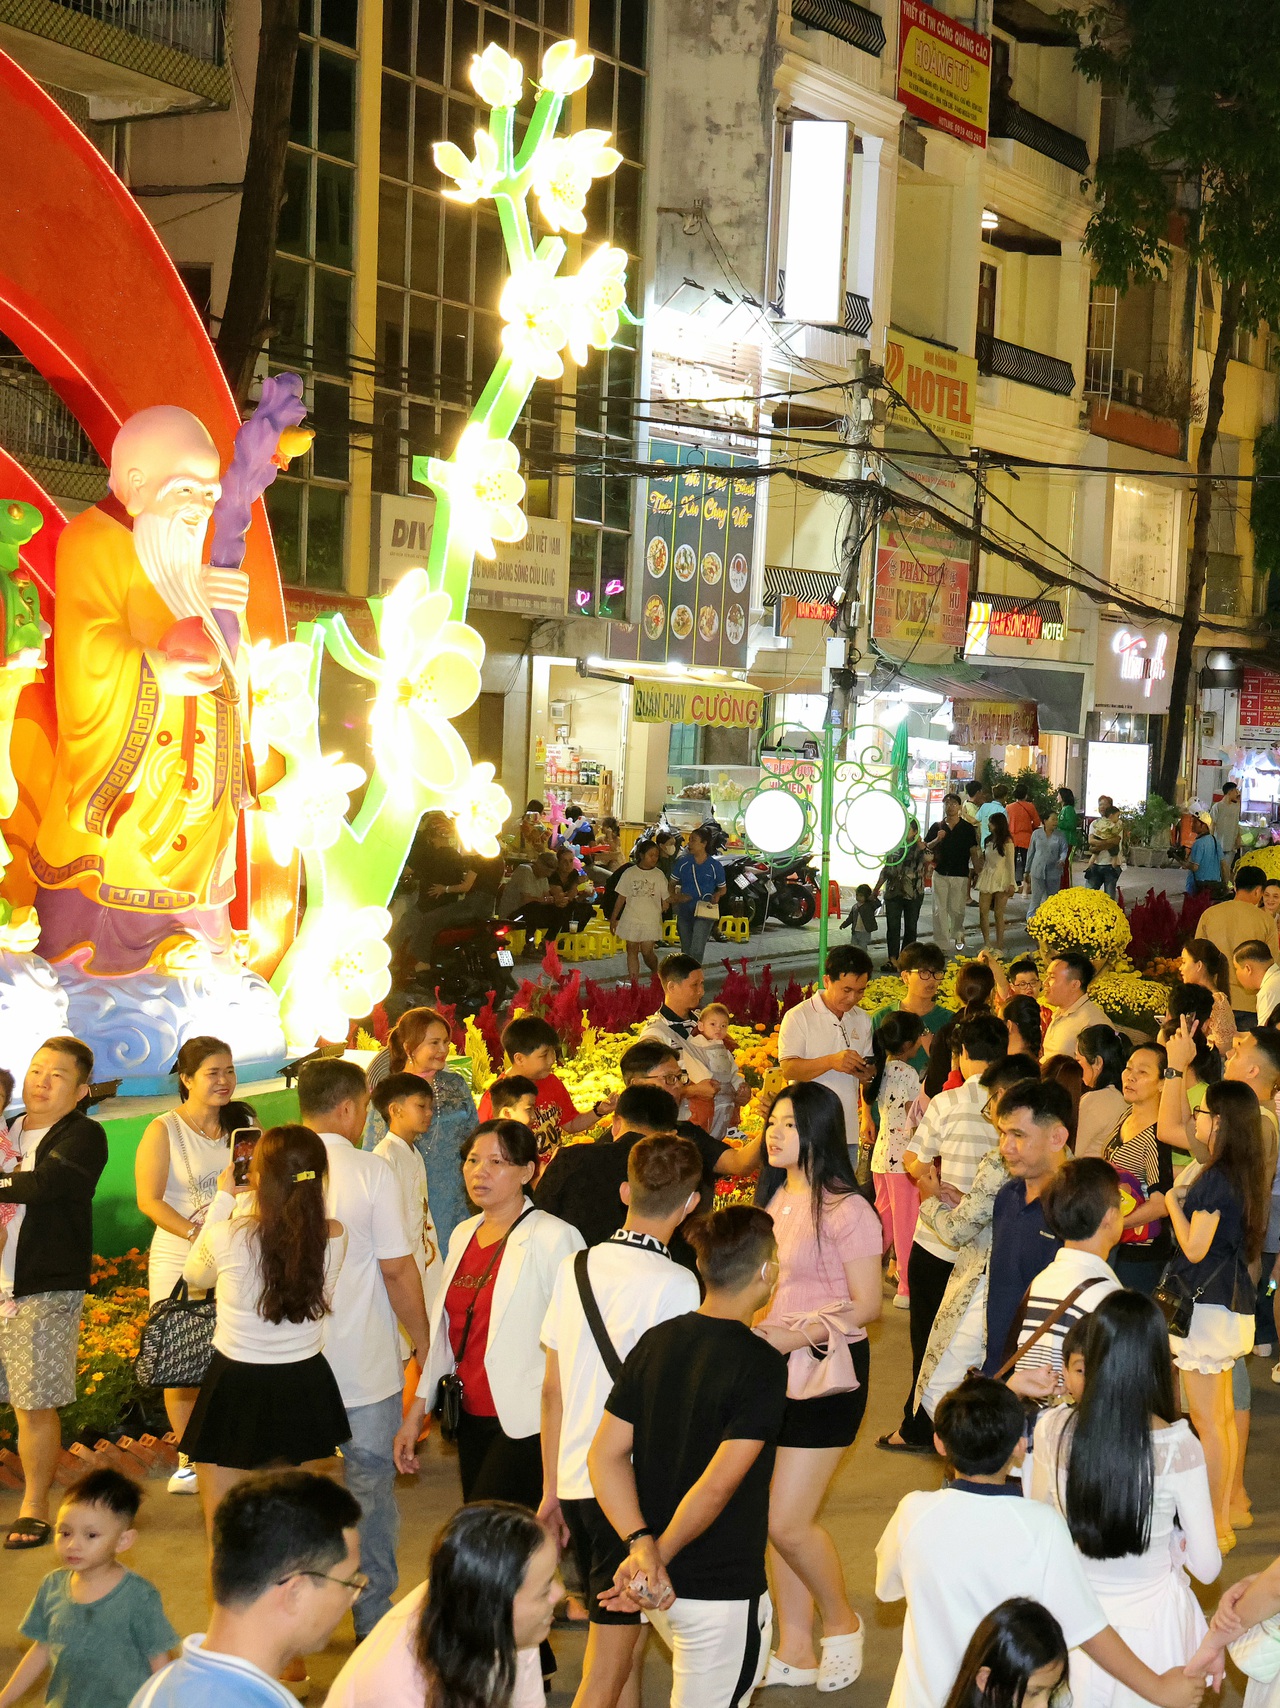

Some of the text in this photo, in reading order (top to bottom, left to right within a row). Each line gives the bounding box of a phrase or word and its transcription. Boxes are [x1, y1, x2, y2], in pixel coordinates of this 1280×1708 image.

[937, 20, 953, 41] CÔNG
[975, 41, 988, 60] CÁO
[915, 37, 954, 84] HOÀNG
[906, 364, 971, 425] HOTEL
[1005, 606, 1025, 637] SÔNG
[1042, 622, 1064, 641] HOTEL
[662, 692, 686, 719] CHAY
[691, 690, 758, 724] CƯỜNG
[1246, 700, 1252, 708] 2
[1246, 716, 1252, 724] 3
